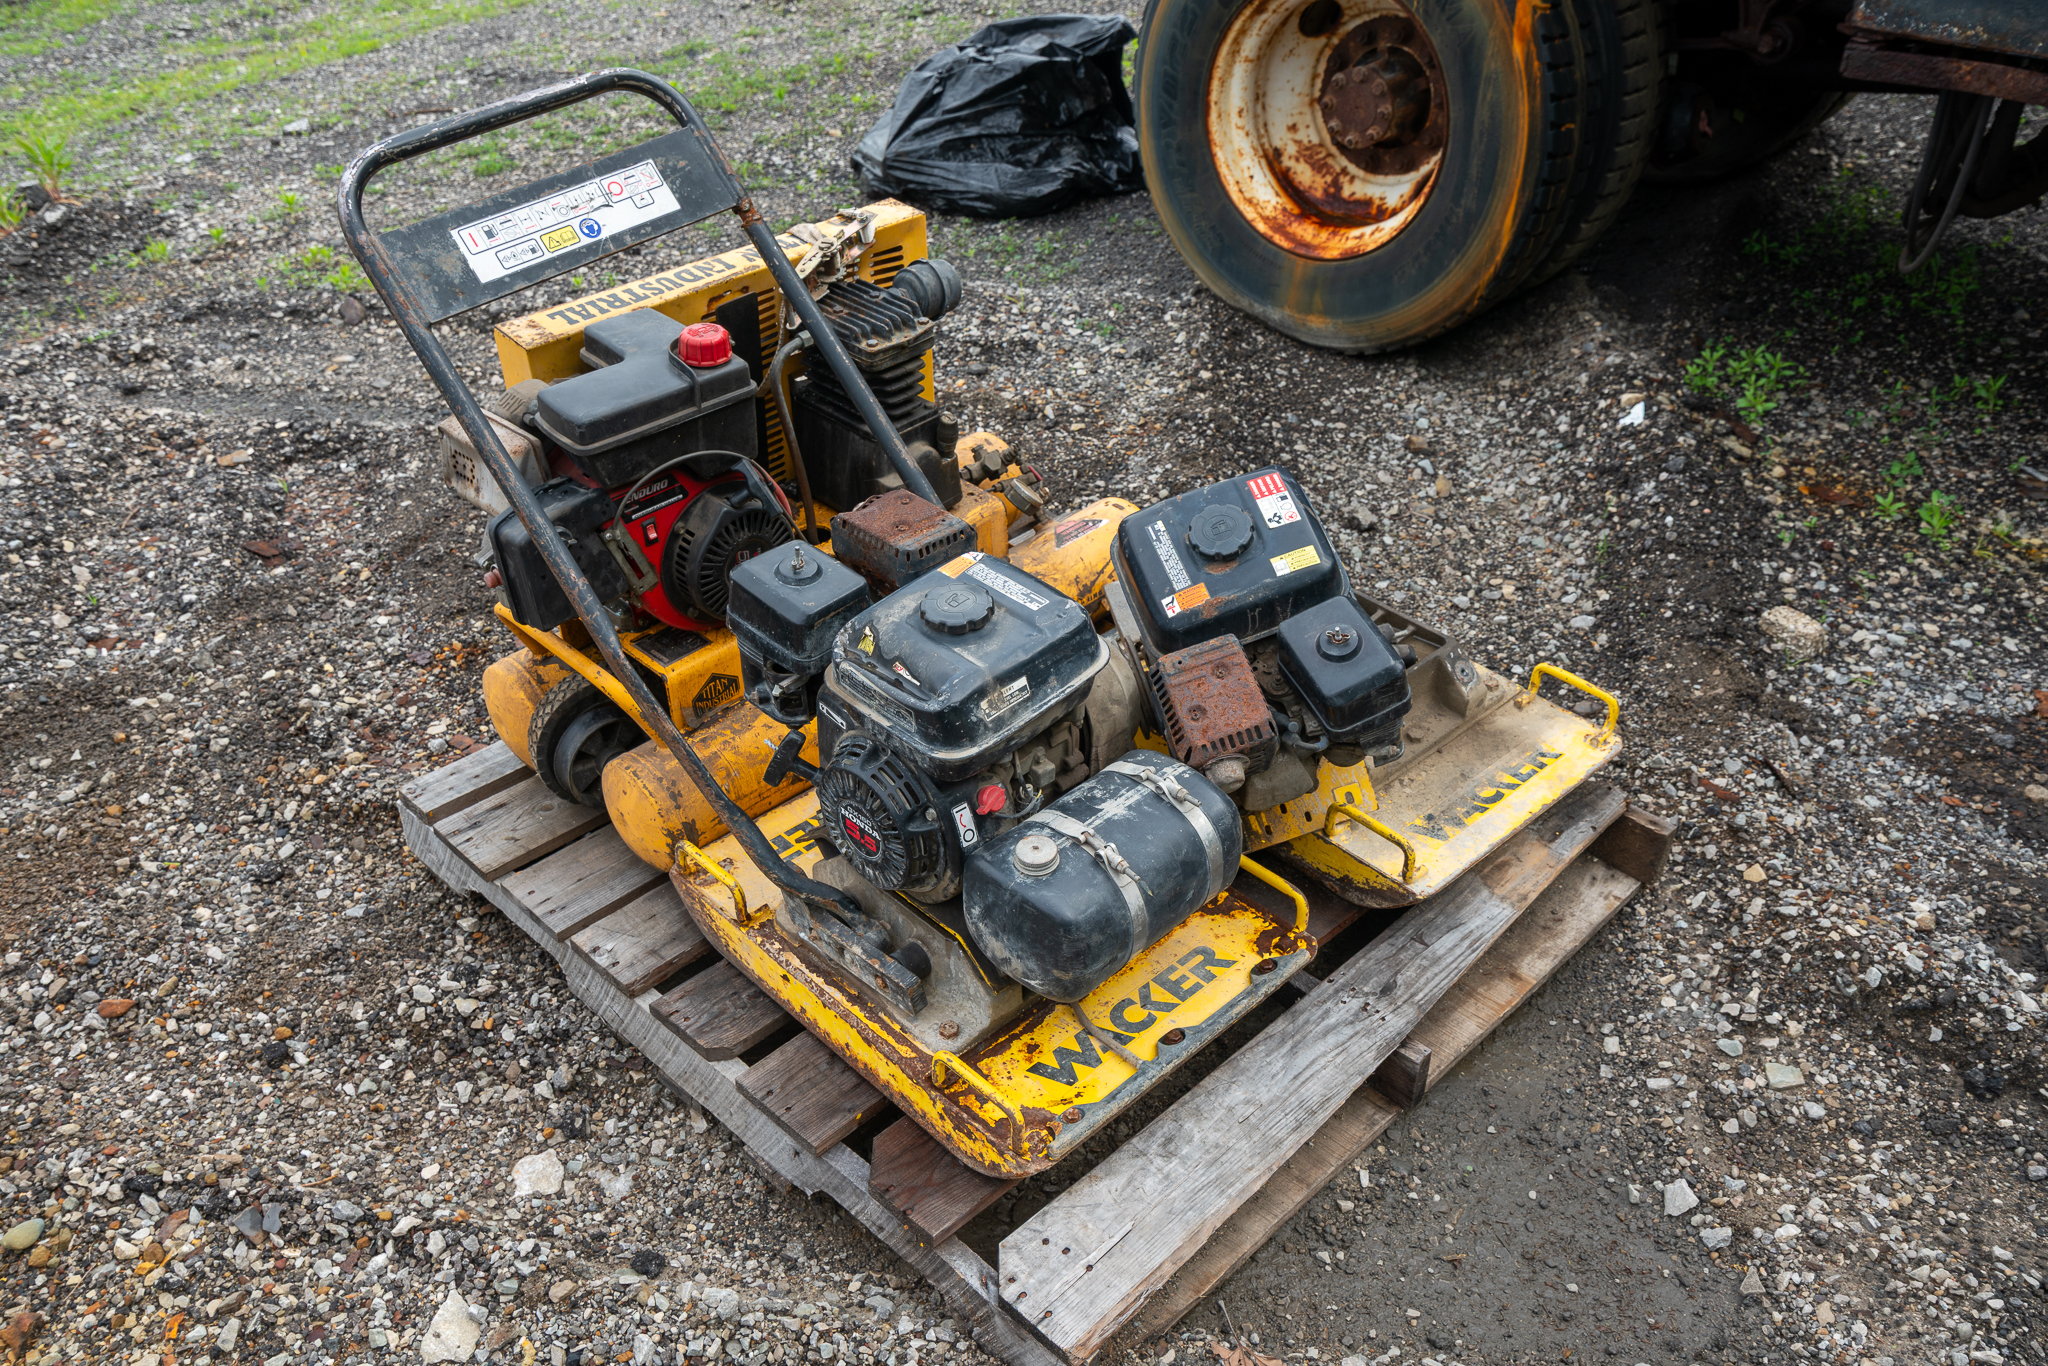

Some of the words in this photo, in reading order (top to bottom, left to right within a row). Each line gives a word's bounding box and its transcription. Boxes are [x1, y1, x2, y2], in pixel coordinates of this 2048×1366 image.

[547, 258, 737, 326] INDUSTRIAL
[695, 682, 739, 716] INDUSTRIAL
[703, 678, 728, 699] TITAN
[840, 806, 881, 841] HONDA
[845, 817, 877, 853] 5.5
[1026, 946, 1239, 1087] WACKER
